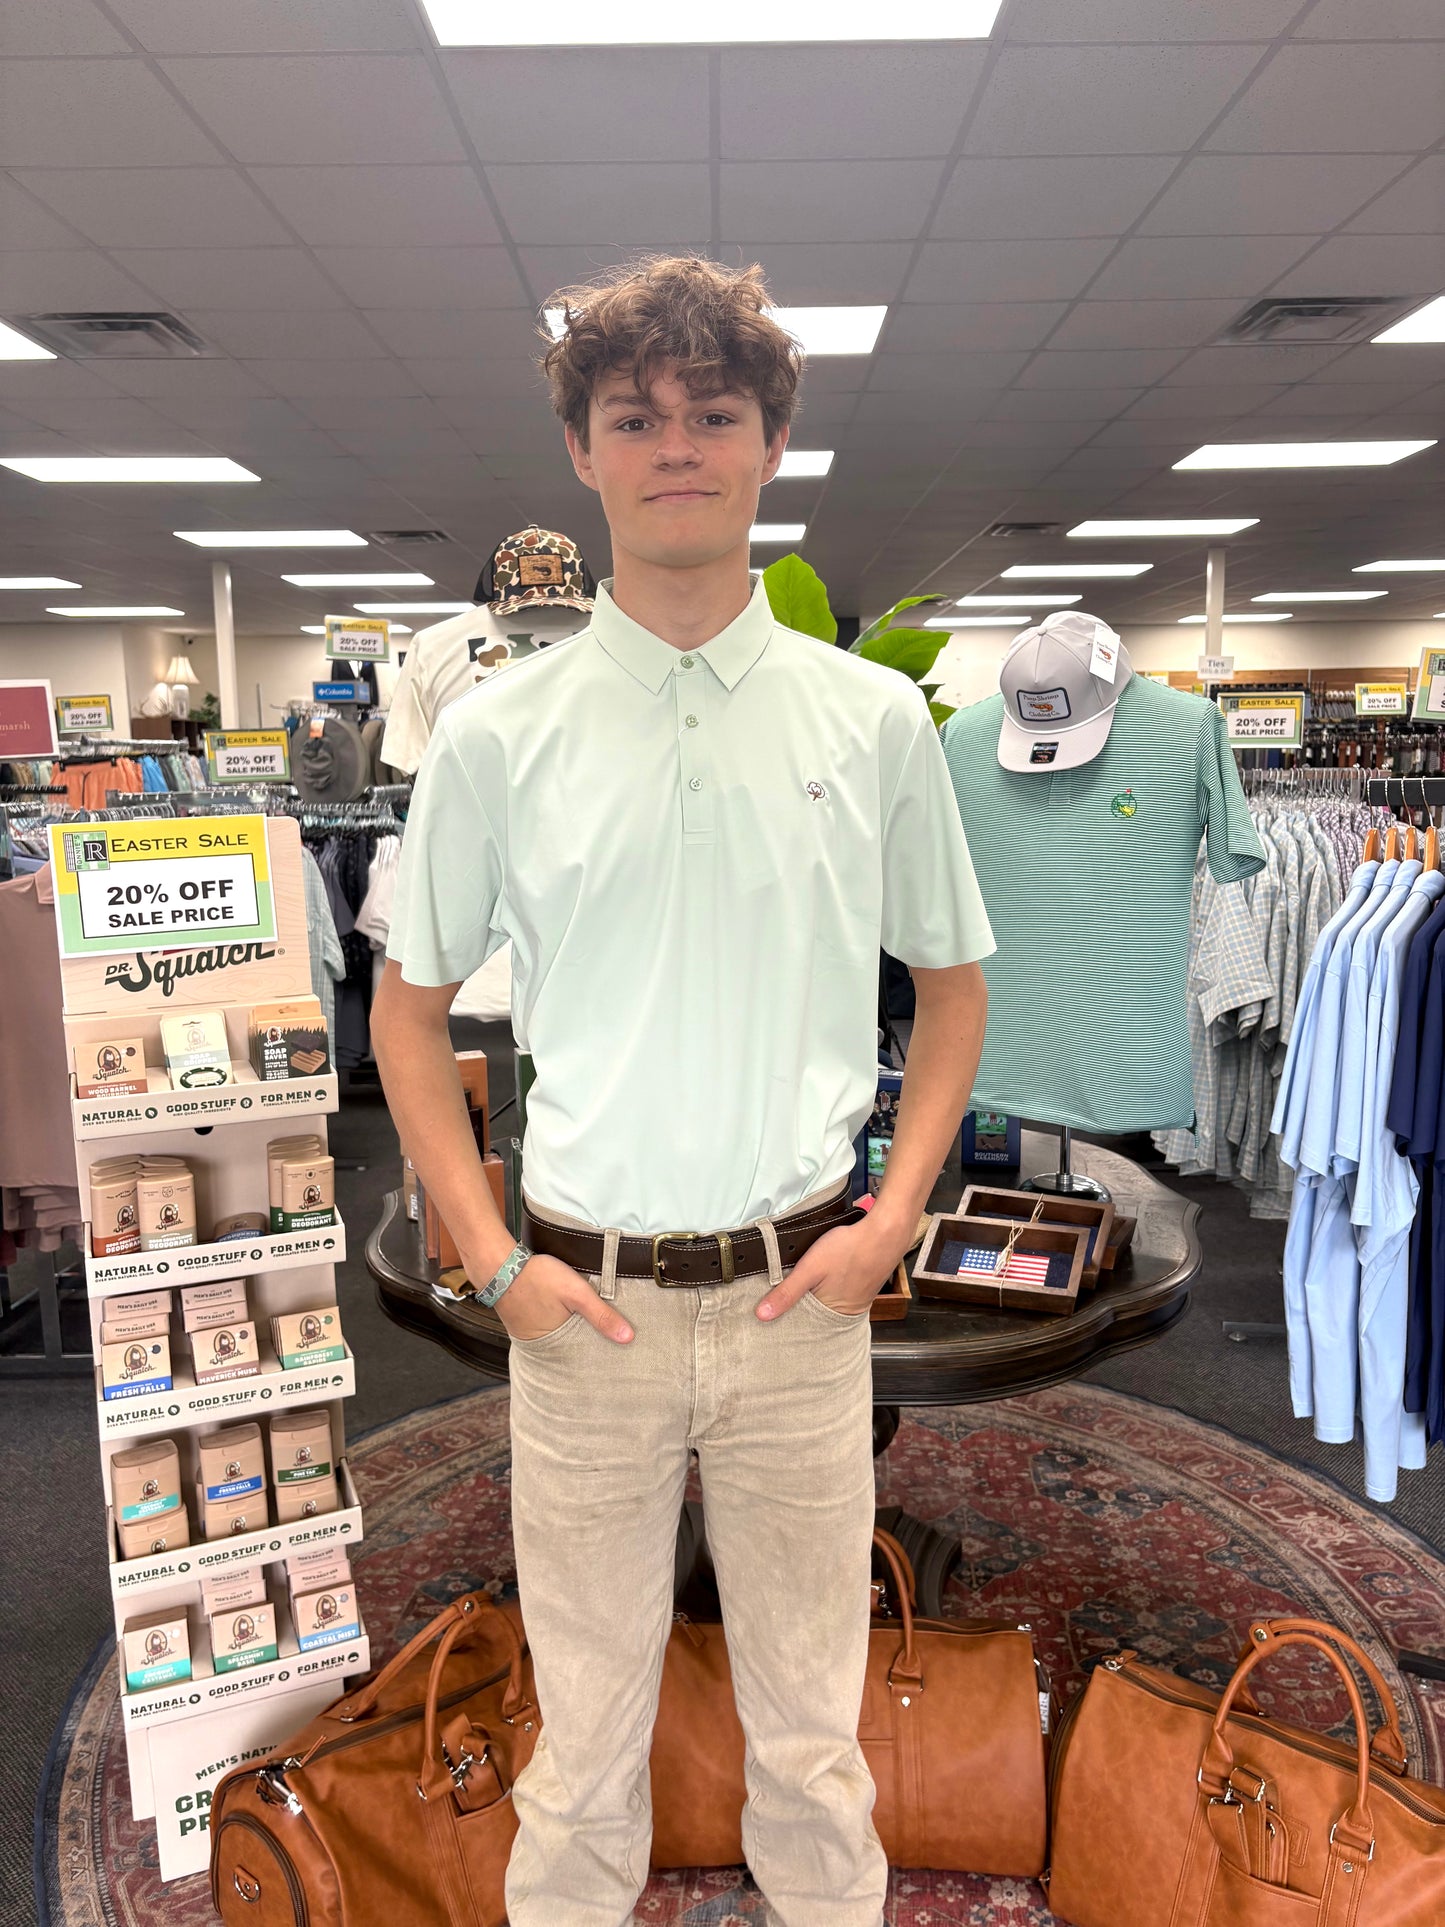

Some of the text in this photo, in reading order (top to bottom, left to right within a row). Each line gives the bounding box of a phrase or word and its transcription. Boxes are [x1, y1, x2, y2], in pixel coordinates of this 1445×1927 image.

[340, 637, 378, 646] 20% OFF
[324, 688, 352, 696] Columbia
[1236, 717, 1287, 727] 20% OFF
[227, 736, 257, 744] EASTER
[225, 754, 276, 765] 20% OFF
[250, 765, 276, 773] PRICE
[111, 833, 249, 853] EASTER SALE
[107, 879, 234, 906] 20% OFF
[108, 906, 234, 928] SALE PRICE
[264, 1047, 287, 1055] SOAP
[261, 1090, 311, 1103] FOR MEN
[166, 1098, 237, 1113] GOOD STUFF
[82, 1109, 141, 1122] NATURAL
[292, 1217, 332, 1228] DEODORANT
[148, 1237, 193, 1249] DEODORANT
[270, 1240, 320, 1254] FOR MEN
[178, 1250, 247, 1267] GOOD STUFF
[95, 1264, 153, 1278] NATURAL
[200, 1367, 258, 1384] MAVERICK MUSK
[111, 1384, 166, 1399] FRESH FALLS
[280, 1382, 301, 1392] FOR
[304, 1377, 328, 1388] MEN
[188, 1397, 220, 1409] GOOD
[222, 1390, 257, 1403] STUFF
[106, 1407, 164, 1424] NATURAL
[289, 1533, 310, 1543] FOR
[313, 1525, 337, 1537] MEN
[198, 1552, 229, 1565] GOOD
[231, 1543, 266, 1557] STUFF
[118, 1565, 175, 1584] NATURAL
[303, 1635, 336, 1649] COASTAL
[338, 1629, 356, 1640] MIST
[297, 1662, 318, 1673] FOR
[321, 1655, 345, 1667] MEN
[209, 1683, 239, 1697] GOOD
[241, 1673, 275, 1688] STUFF
[131, 1697, 186, 1715] NATURAL
[195, 1754, 239, 1781] MEN'S
